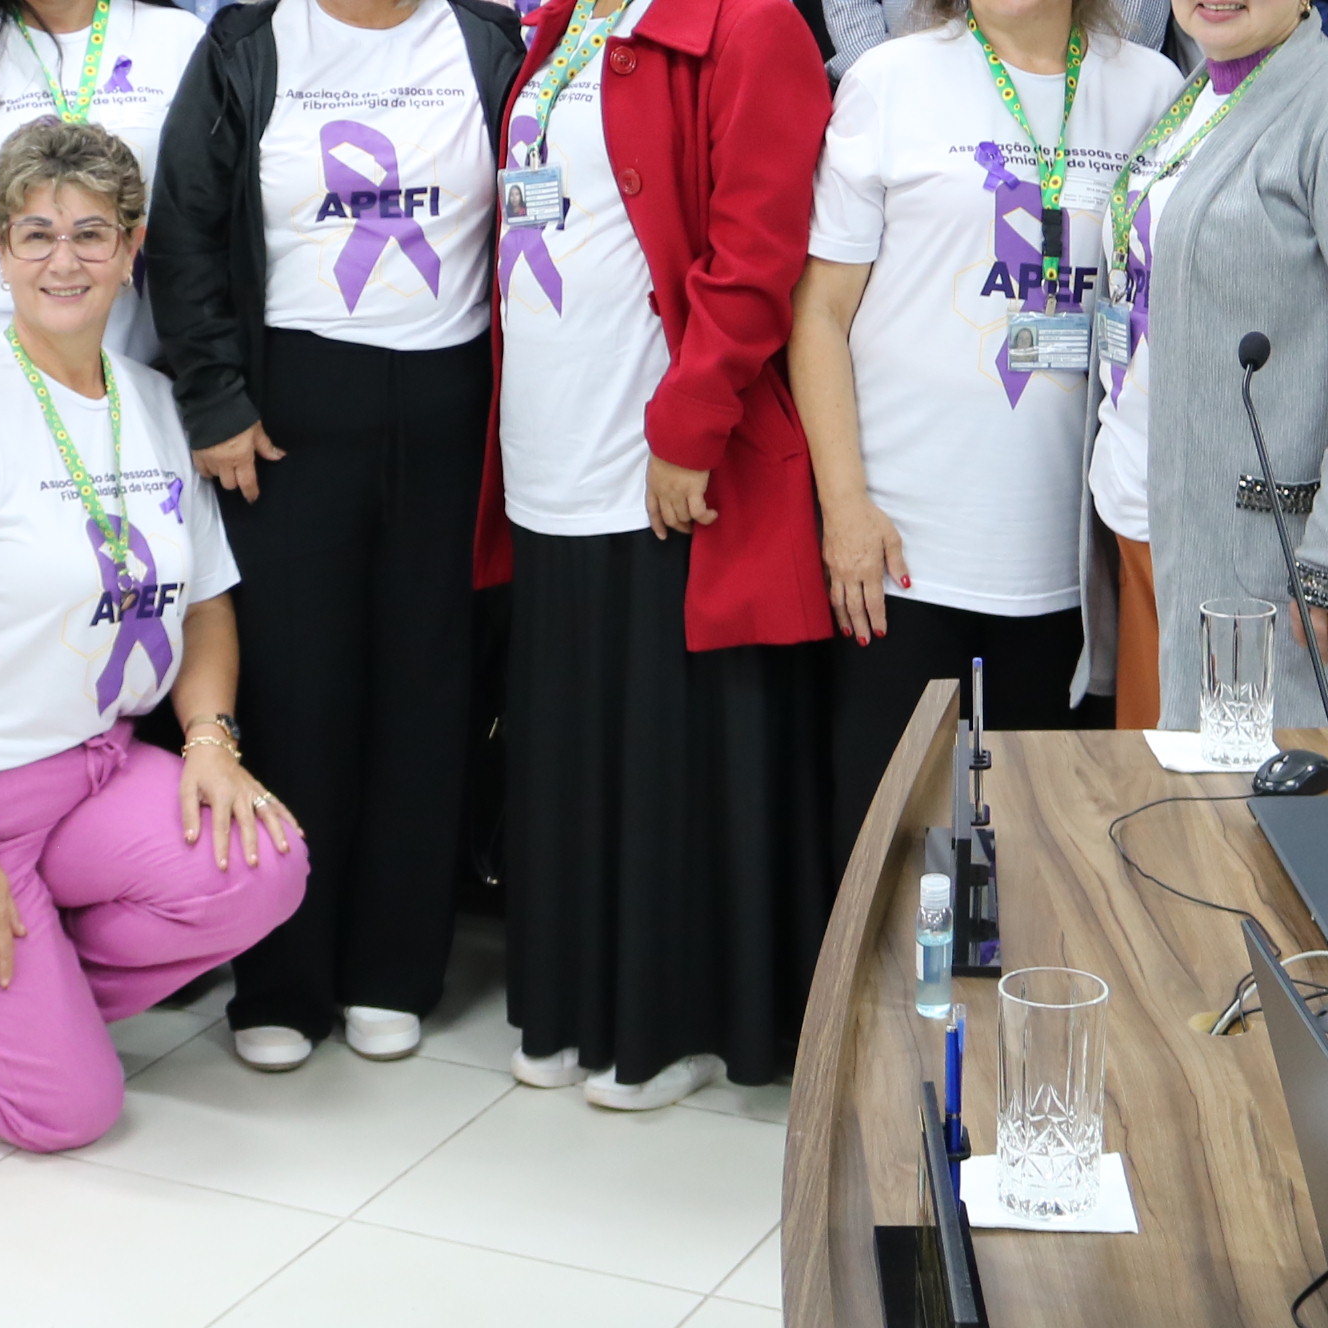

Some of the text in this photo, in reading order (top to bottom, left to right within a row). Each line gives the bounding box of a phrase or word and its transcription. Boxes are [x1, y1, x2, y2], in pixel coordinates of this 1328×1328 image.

[136, 85, 164, 96] com
[436, 86, 465, 97] com
[93, 96, 109, 106] de
[111, 95, 148, 106] Içara
[390, 97, 406, 109] de
[409, 98, 445, 109] Içara
[1066, 157, 1086, 169] de
[315, 185, 440, 223] APEFI
